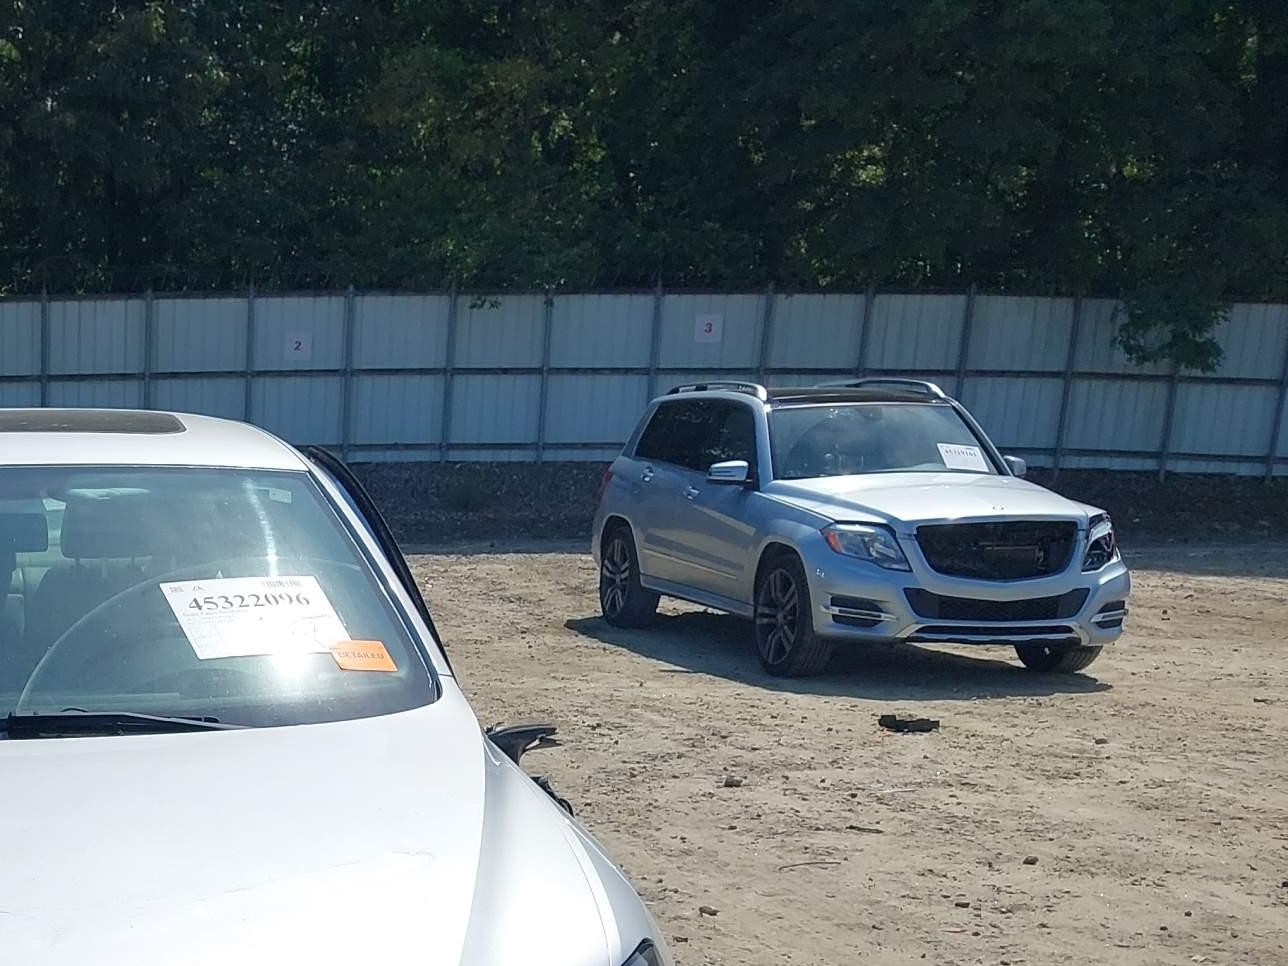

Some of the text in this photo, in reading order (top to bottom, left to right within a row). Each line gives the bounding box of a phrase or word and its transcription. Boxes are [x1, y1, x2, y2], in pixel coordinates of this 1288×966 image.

[704, 322, 713, 334] 3
[294, 340, 302, 351] 2
[188, 592, 311, 611] 45322096
[337, 650, 385, 660] DETAILED
